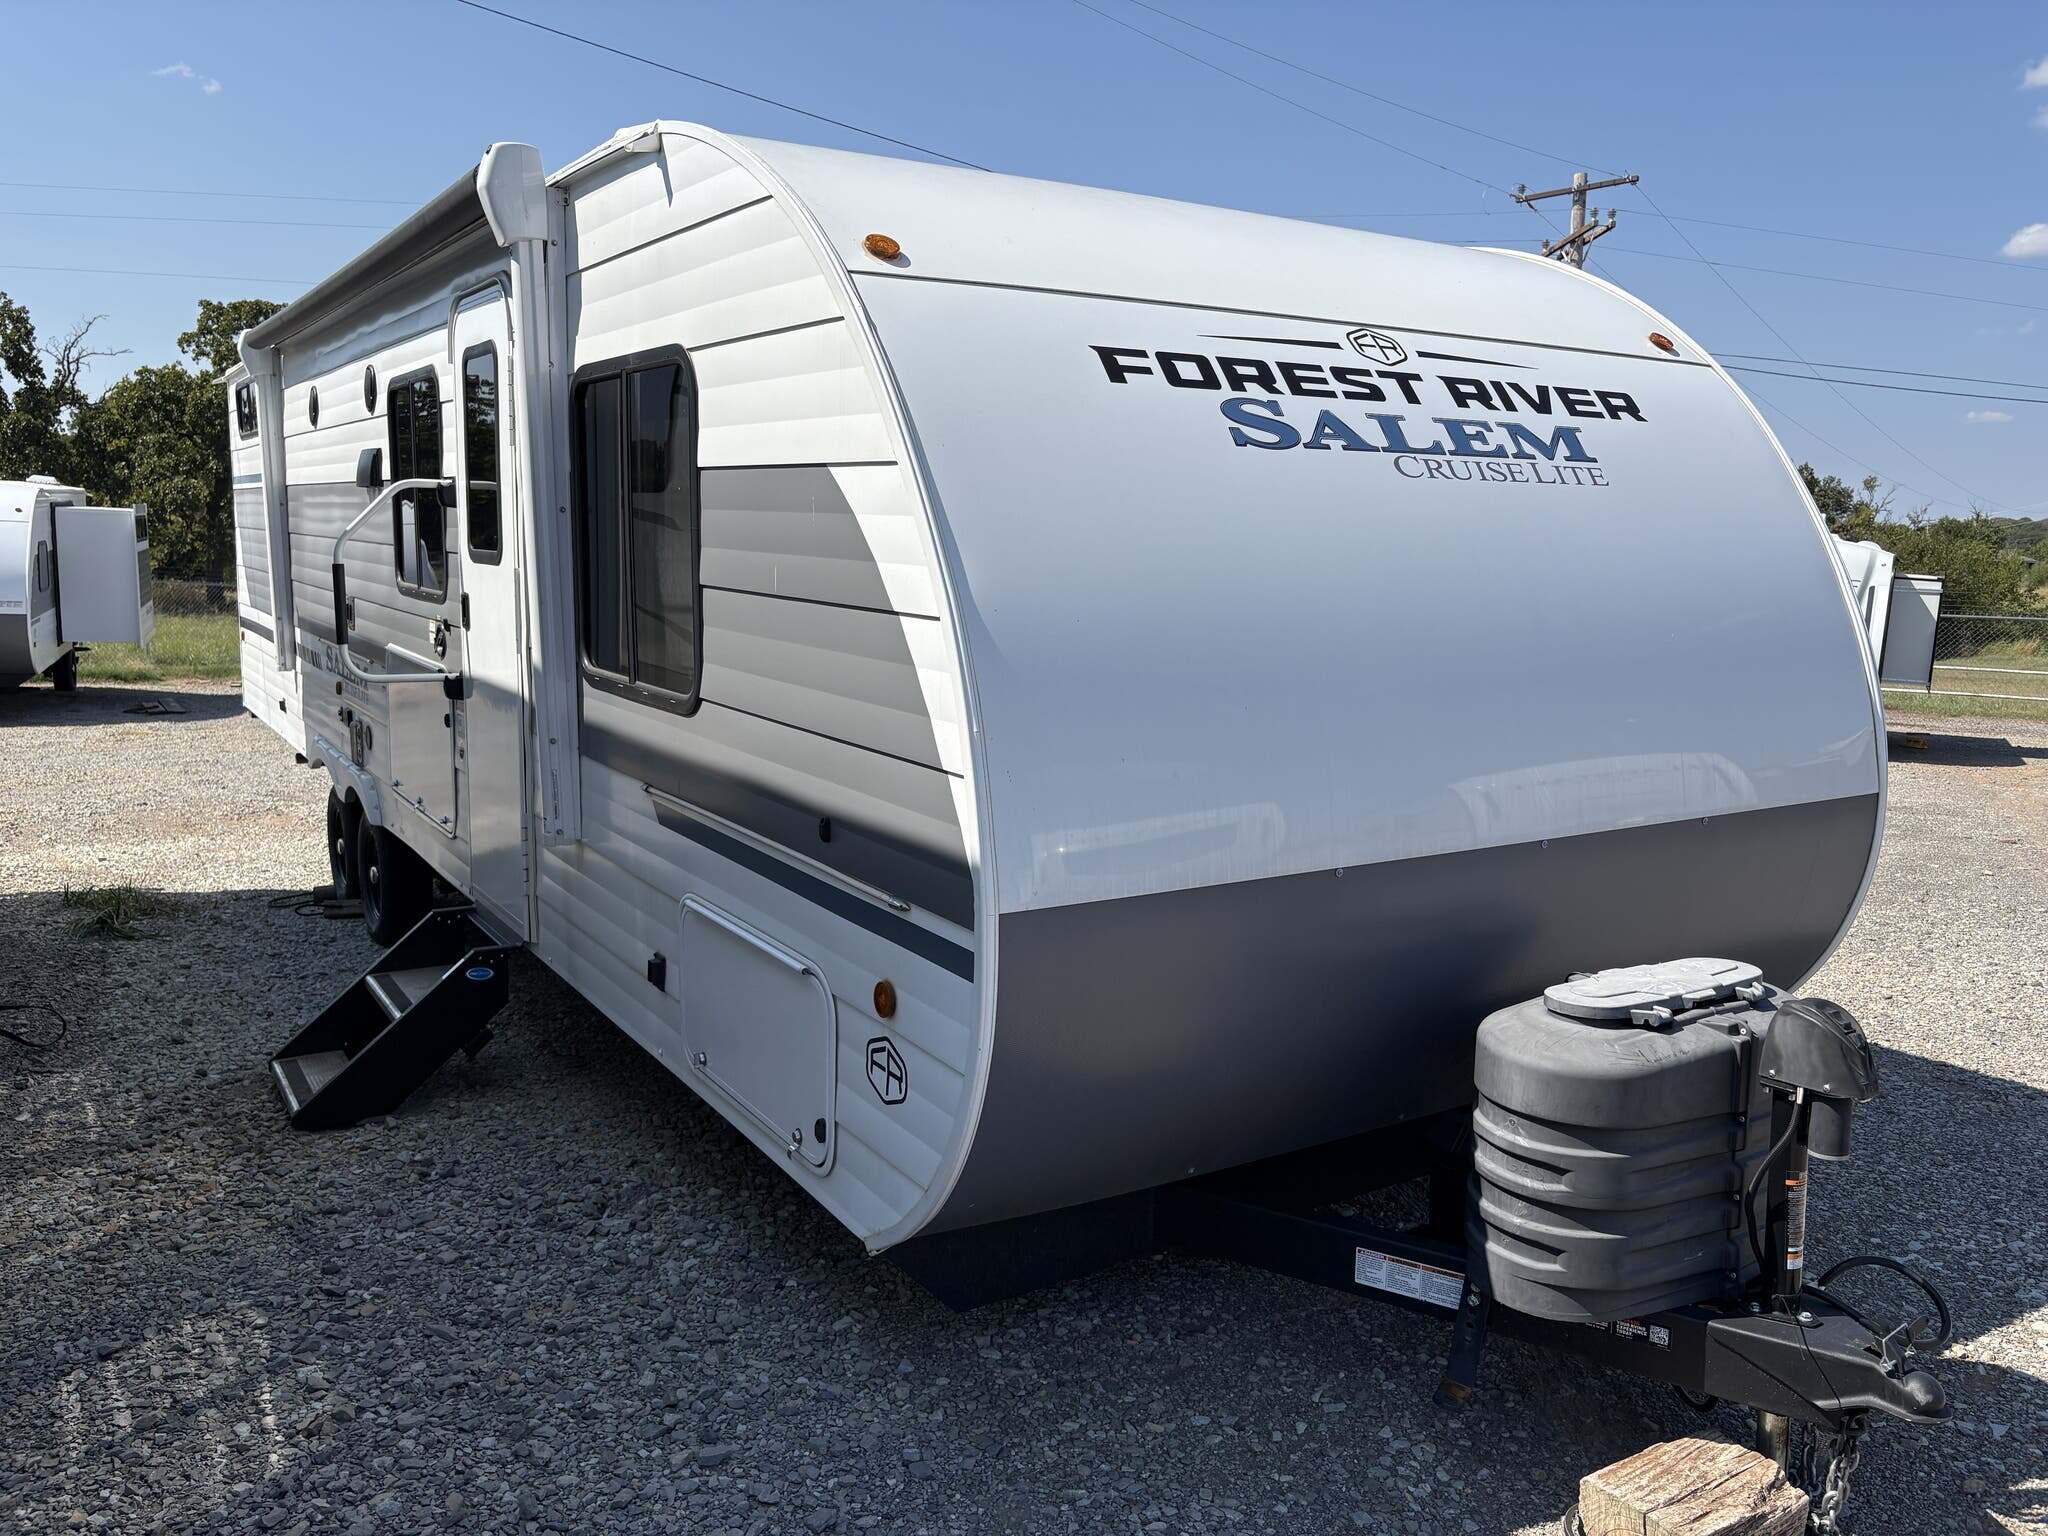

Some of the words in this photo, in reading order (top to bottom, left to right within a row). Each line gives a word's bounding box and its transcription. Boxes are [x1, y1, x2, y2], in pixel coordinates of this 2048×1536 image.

[1088, 345, 1423, 405] FOREST
[1436, 375, 1649, 422] RIVER
[1220, 397, 1598, 464] SALEM
[1393, 454, 1530, 484] CRUISE
[1528, 461, 1609, 487] LITE
